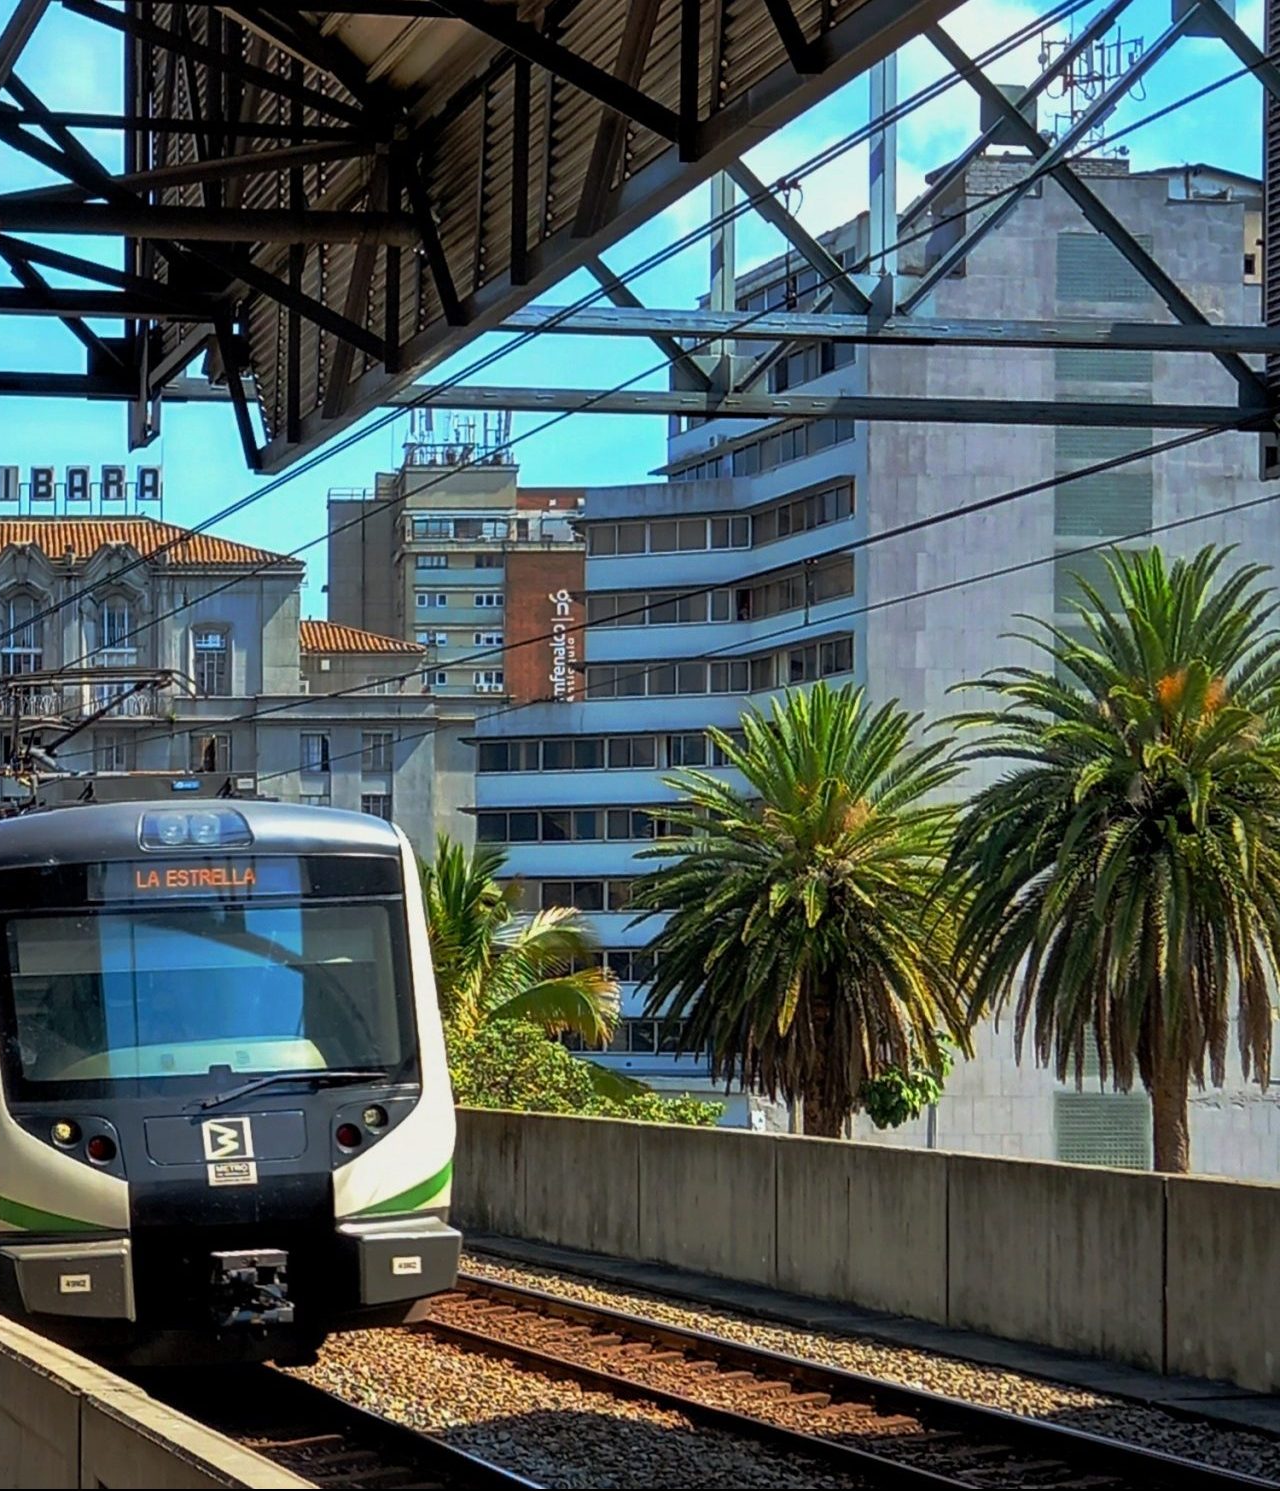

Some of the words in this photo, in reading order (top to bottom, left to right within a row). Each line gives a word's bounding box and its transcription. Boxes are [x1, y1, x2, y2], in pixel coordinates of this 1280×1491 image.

[549, 624, 566, 702] mfenalco
[136, 870, 160, 888] LA
[166, 868, 256, 887] ESTRELLA
